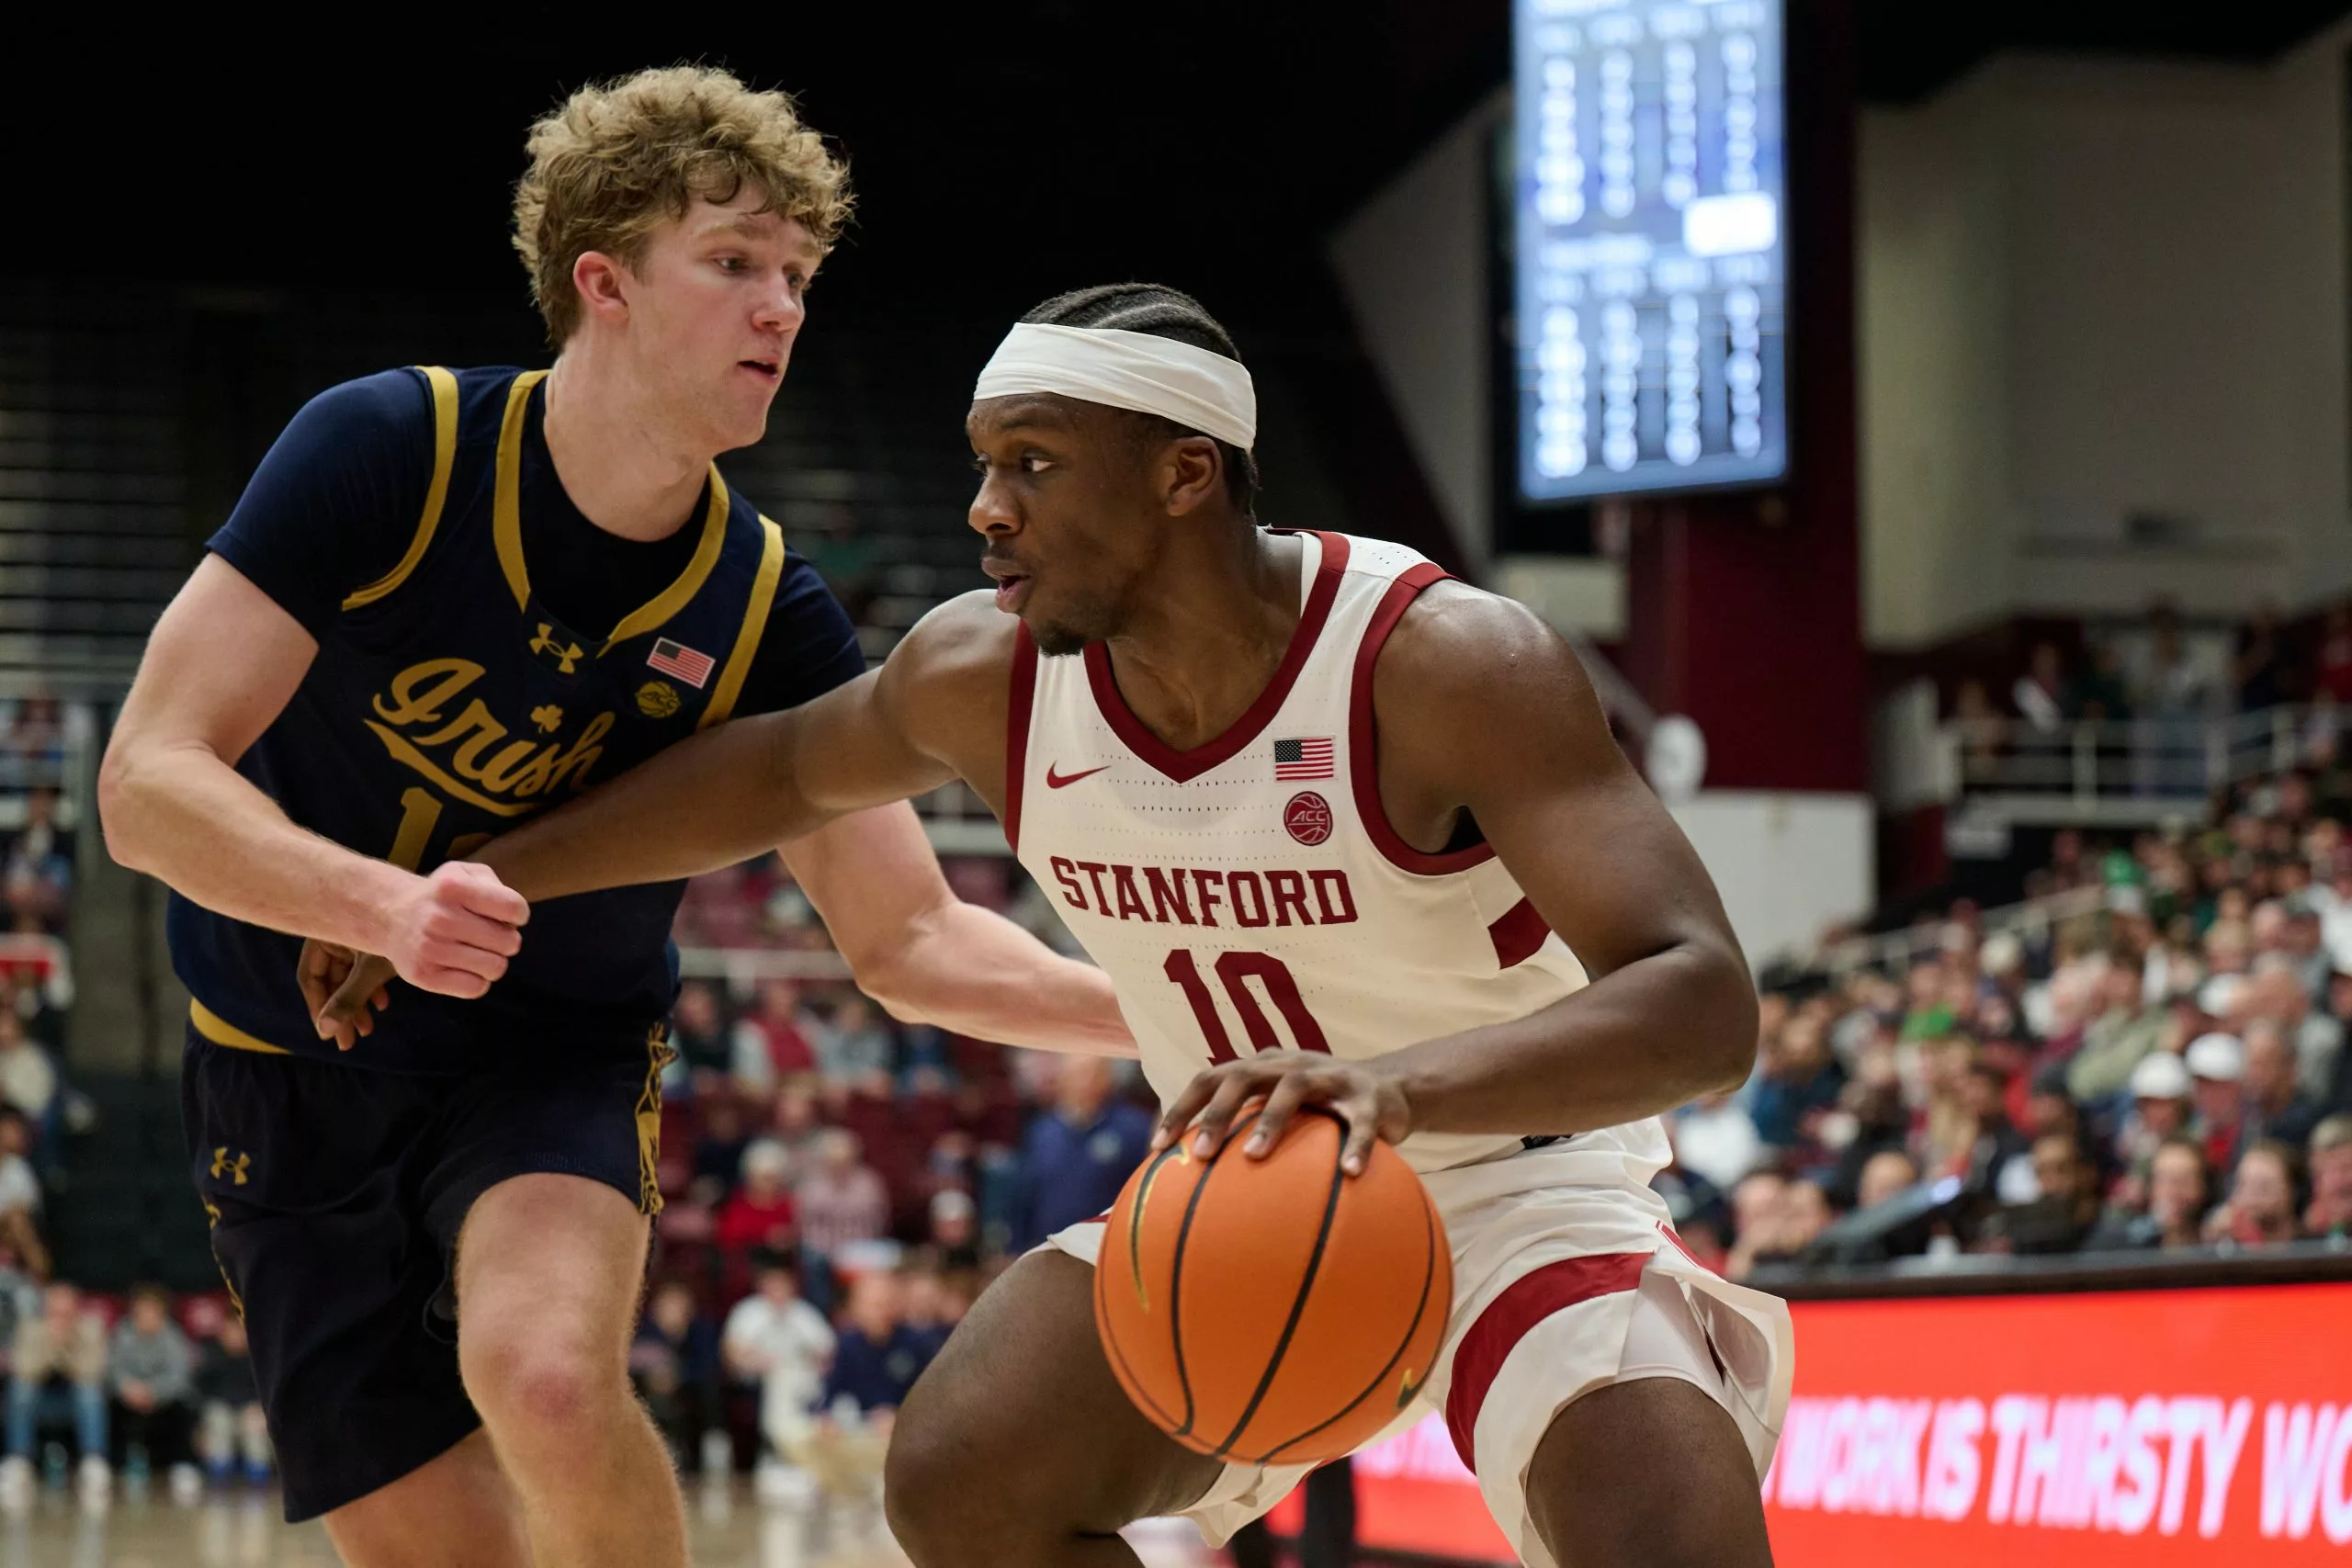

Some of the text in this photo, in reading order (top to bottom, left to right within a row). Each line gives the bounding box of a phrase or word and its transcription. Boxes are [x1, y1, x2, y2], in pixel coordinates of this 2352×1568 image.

[370, 658, 616, 799] Irish
[387, 787, 494, 873] 1
[1291, 810, 1329, 823] ACC
[1050, 855, 1359, 928] STANFORD
[1163, 949, 1333, 1066] 10
[1778, 1395, 1932, 1517] WORK
[1921, 1395, 1986, 1522] IS
[1987, 1393, 2255, 1539] THIRSTY
